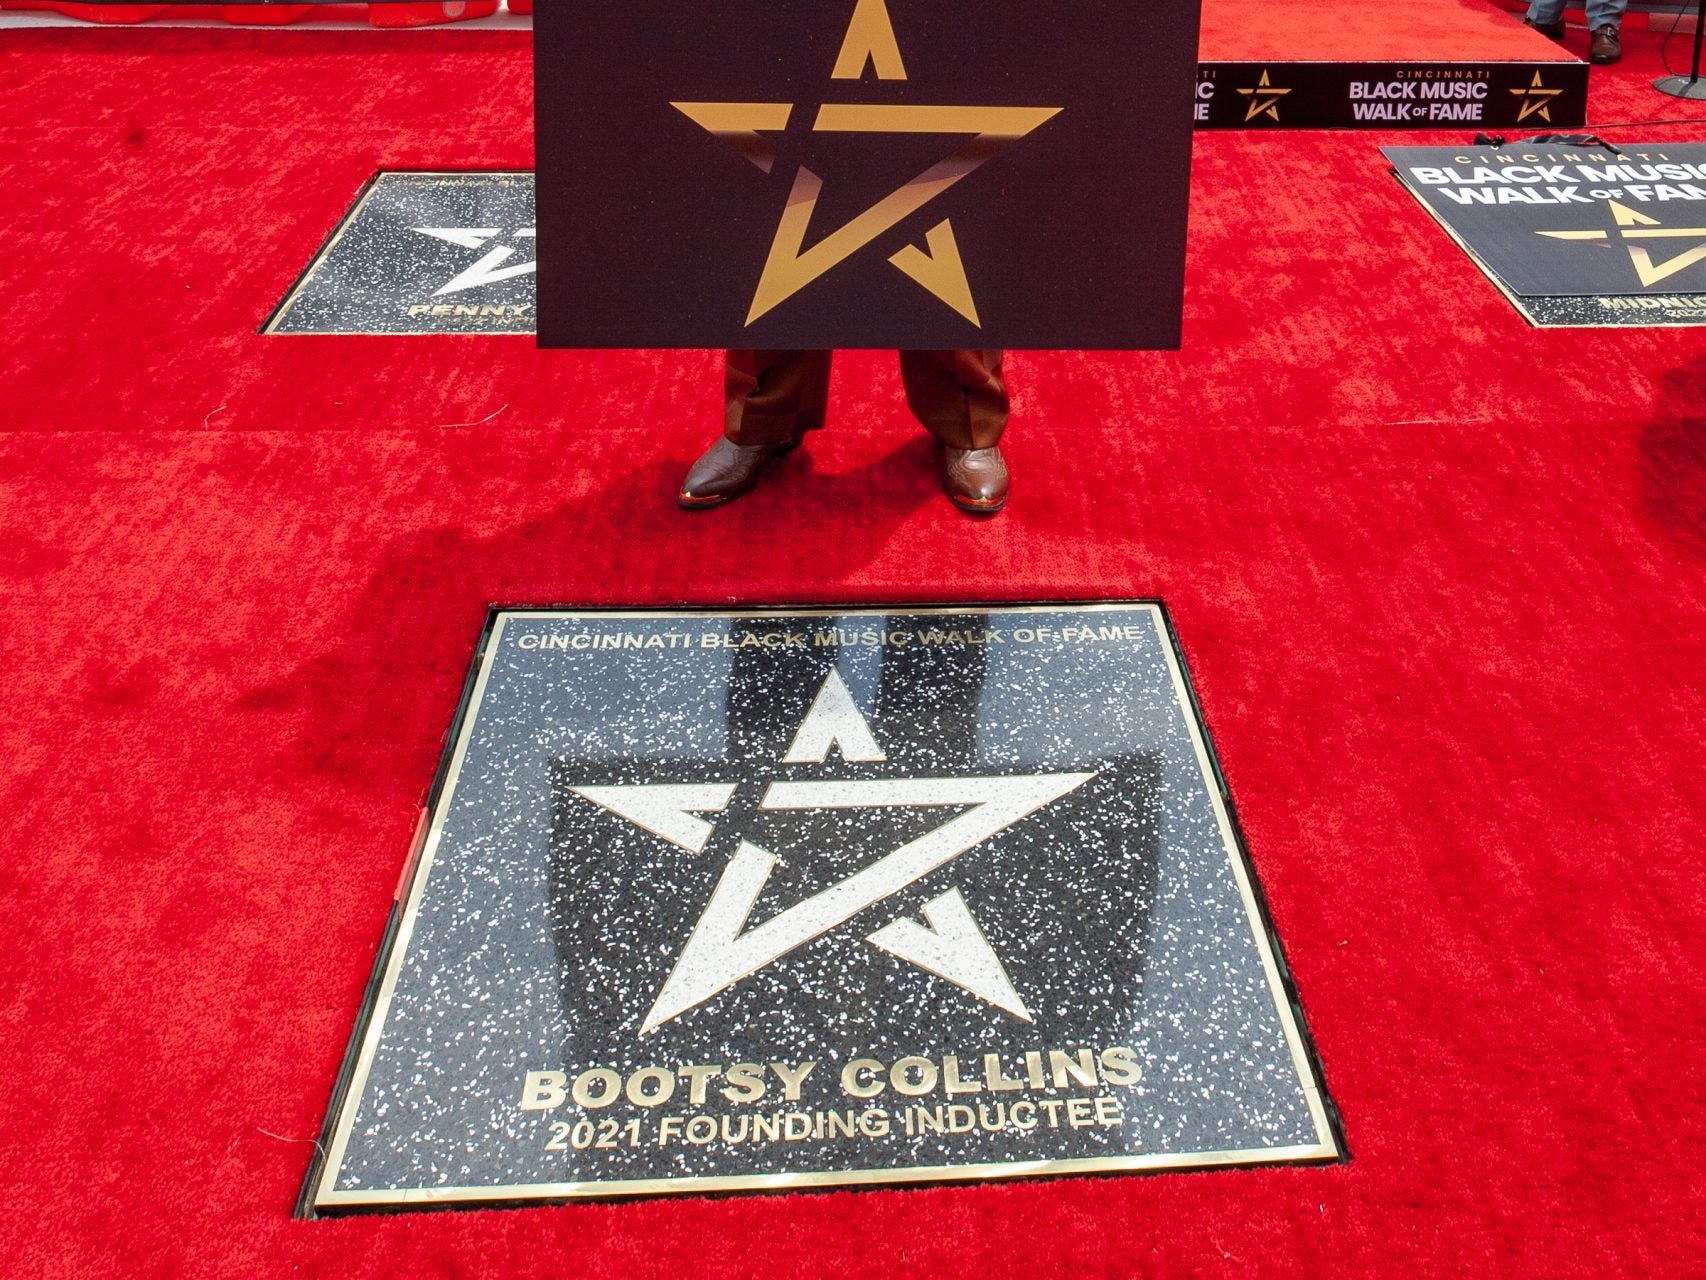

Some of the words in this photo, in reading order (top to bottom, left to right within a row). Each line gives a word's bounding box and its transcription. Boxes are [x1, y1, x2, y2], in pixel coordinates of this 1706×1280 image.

[1396, 70, 1491, 79] CINCINNATI
[1349, 81, 1416, 99] BLACK
[1420, 81, 1488, 100] MUSIC
[1353, 103, 1411, 120] WALK
[1412, 107, 1427, 116] OF
[1429, 103, 1483, 120] FAME
[1454, 153, 1669, 164] CINCINNATI
[1409, 165, 1581, 184] BLACK
[1438, 186, 1595, 205] WALK
[1589, 189, 1624, 199] OF
[406, 304, 534, 316] PENNY
[518, 633, 691, 650] CINCINNATI
[701, 632, 803, 649] BLACK
[814, 630, 908, 647] MUSIC
[918, 629, 1006, 646] WALK
[1013, 627, 1056, 643] OF
[1063, 626, 1144, 642] FAME
[520, 1061, 818, 1110] BOOTSY
[840, 1046, 1144, 1098] COLLINS
[544, 1118, 641, 1151] 2021
[658, 1108, 890, 1146] FOUNDING
[905, 1096, 1124, 1135] INDUCTEE
